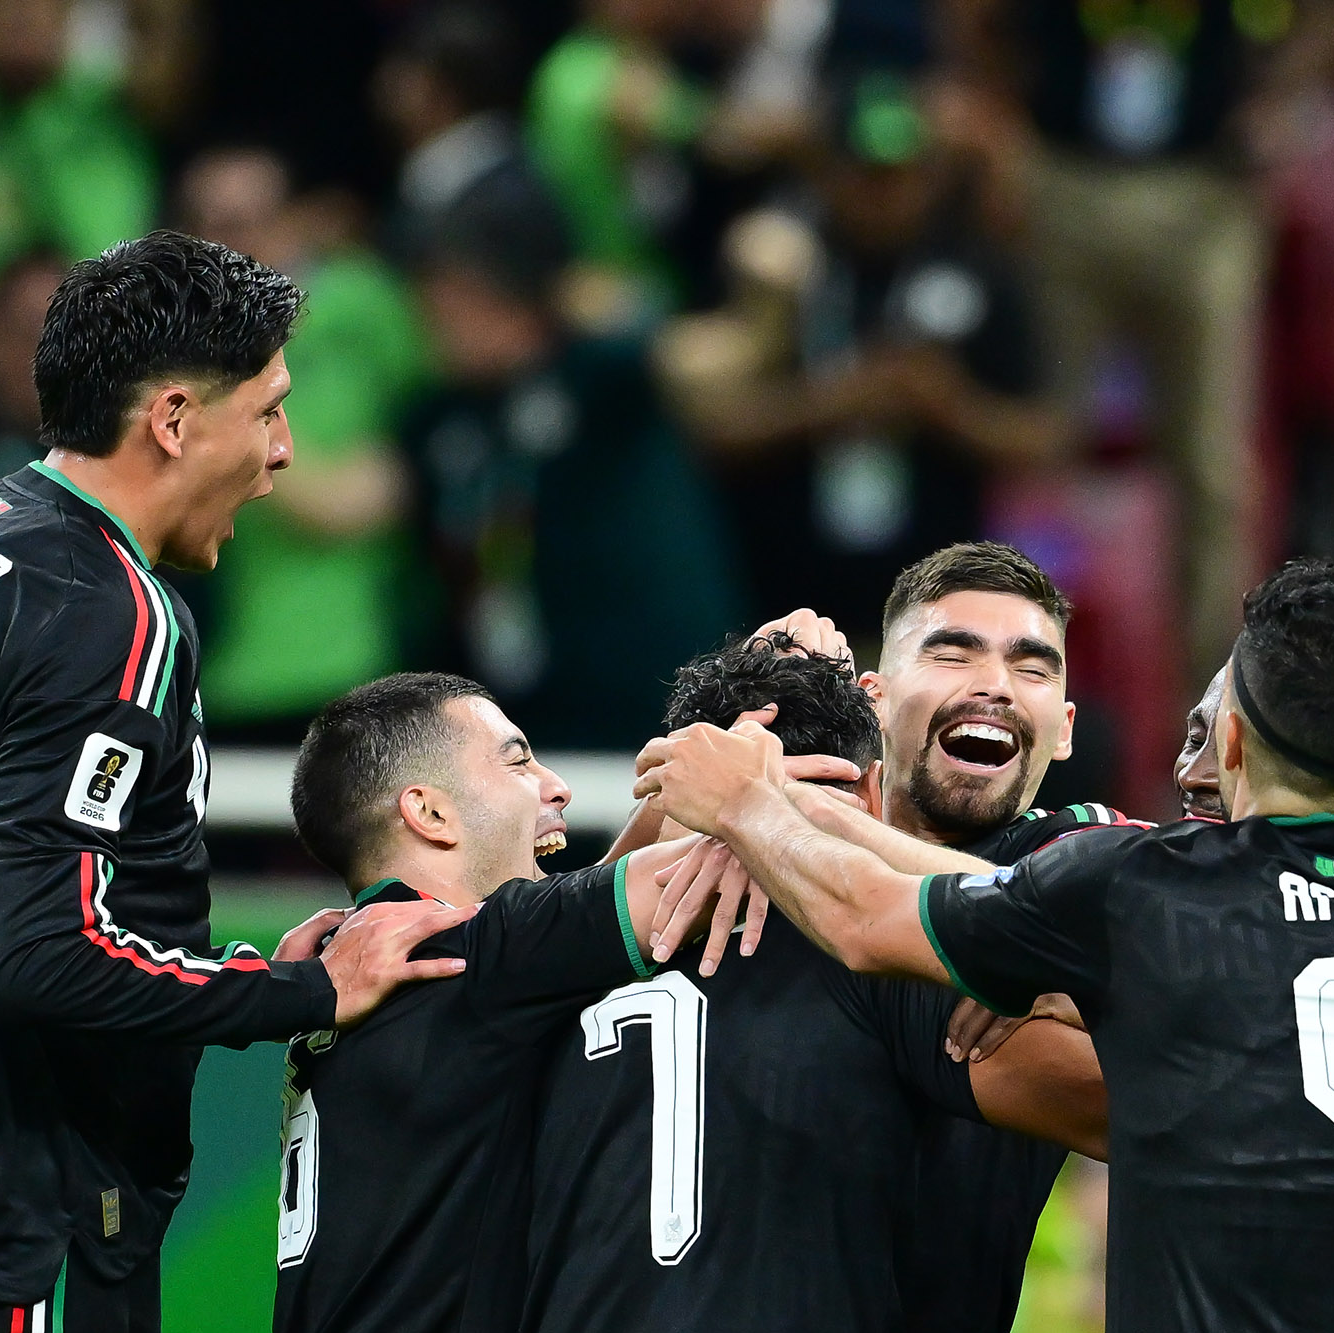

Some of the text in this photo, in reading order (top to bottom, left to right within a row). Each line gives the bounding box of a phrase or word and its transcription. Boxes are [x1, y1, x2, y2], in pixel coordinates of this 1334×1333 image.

[82, 800, 97, 809] WORLD
[79, 806, 105, 821] 2026
[580, 970, 708, 1266] 7
